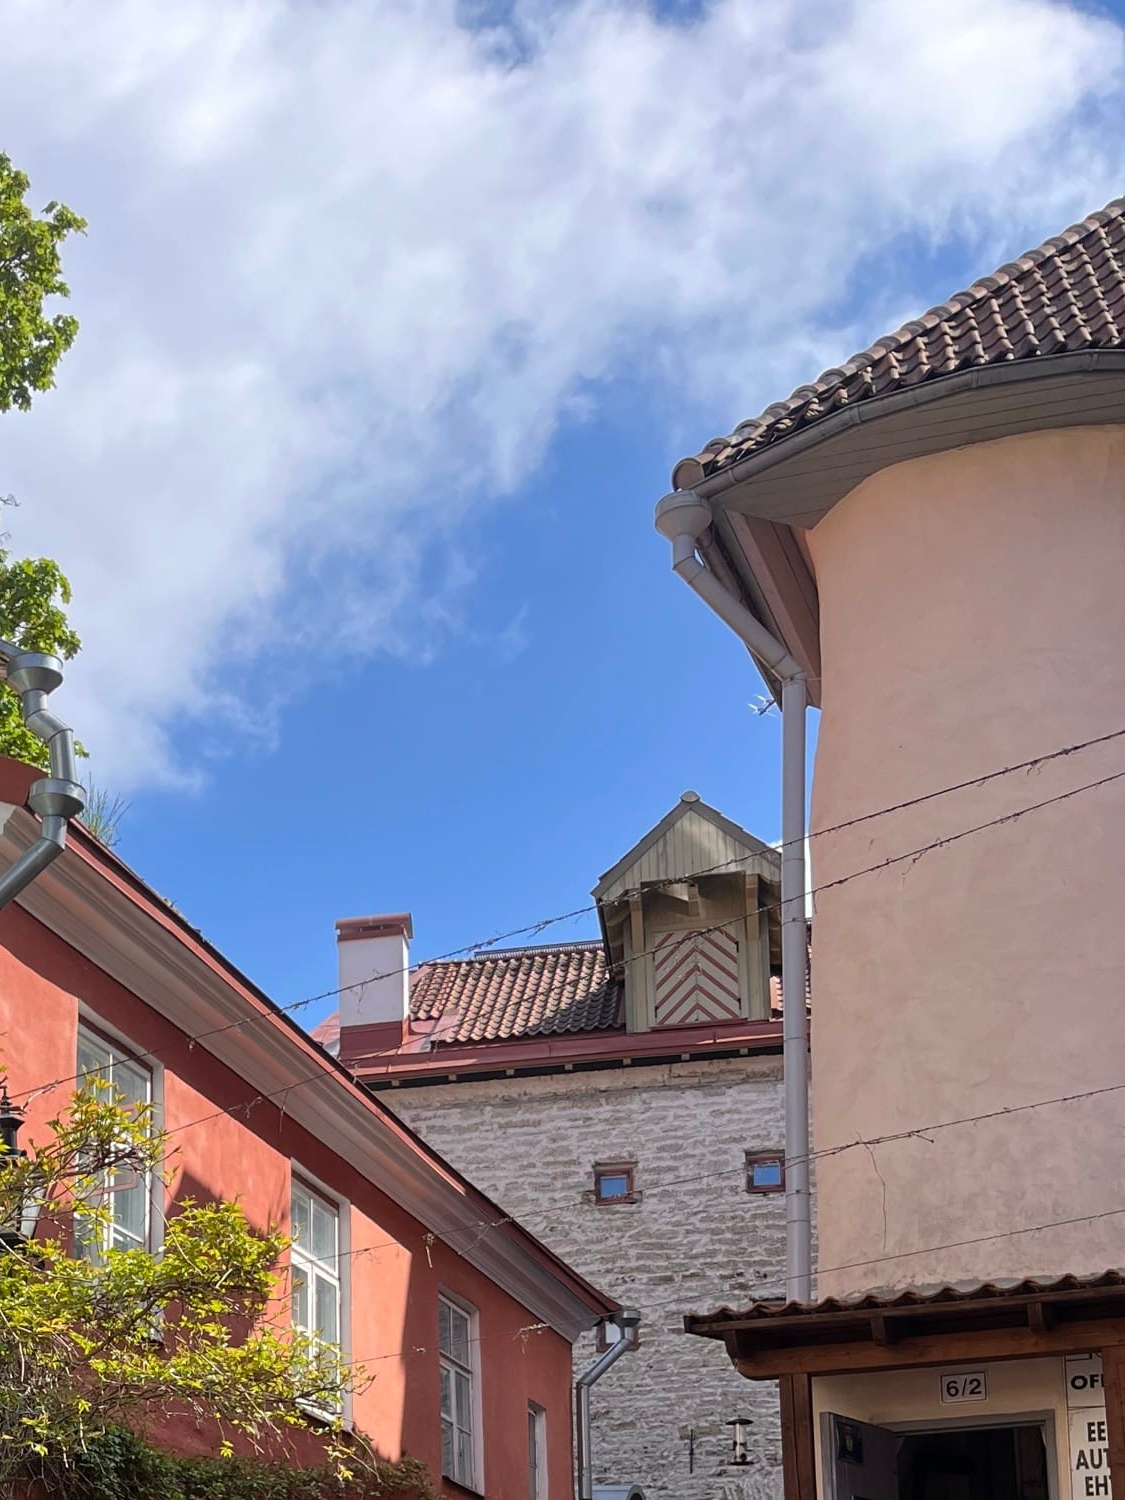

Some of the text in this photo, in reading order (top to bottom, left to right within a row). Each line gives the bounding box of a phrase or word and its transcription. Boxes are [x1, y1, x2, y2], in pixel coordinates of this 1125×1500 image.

[946, 1377, 982, 1397] 6/2
[1071, 1374, 1104, 1389] OF
[1085, 1475, 1111, 1496] EH
